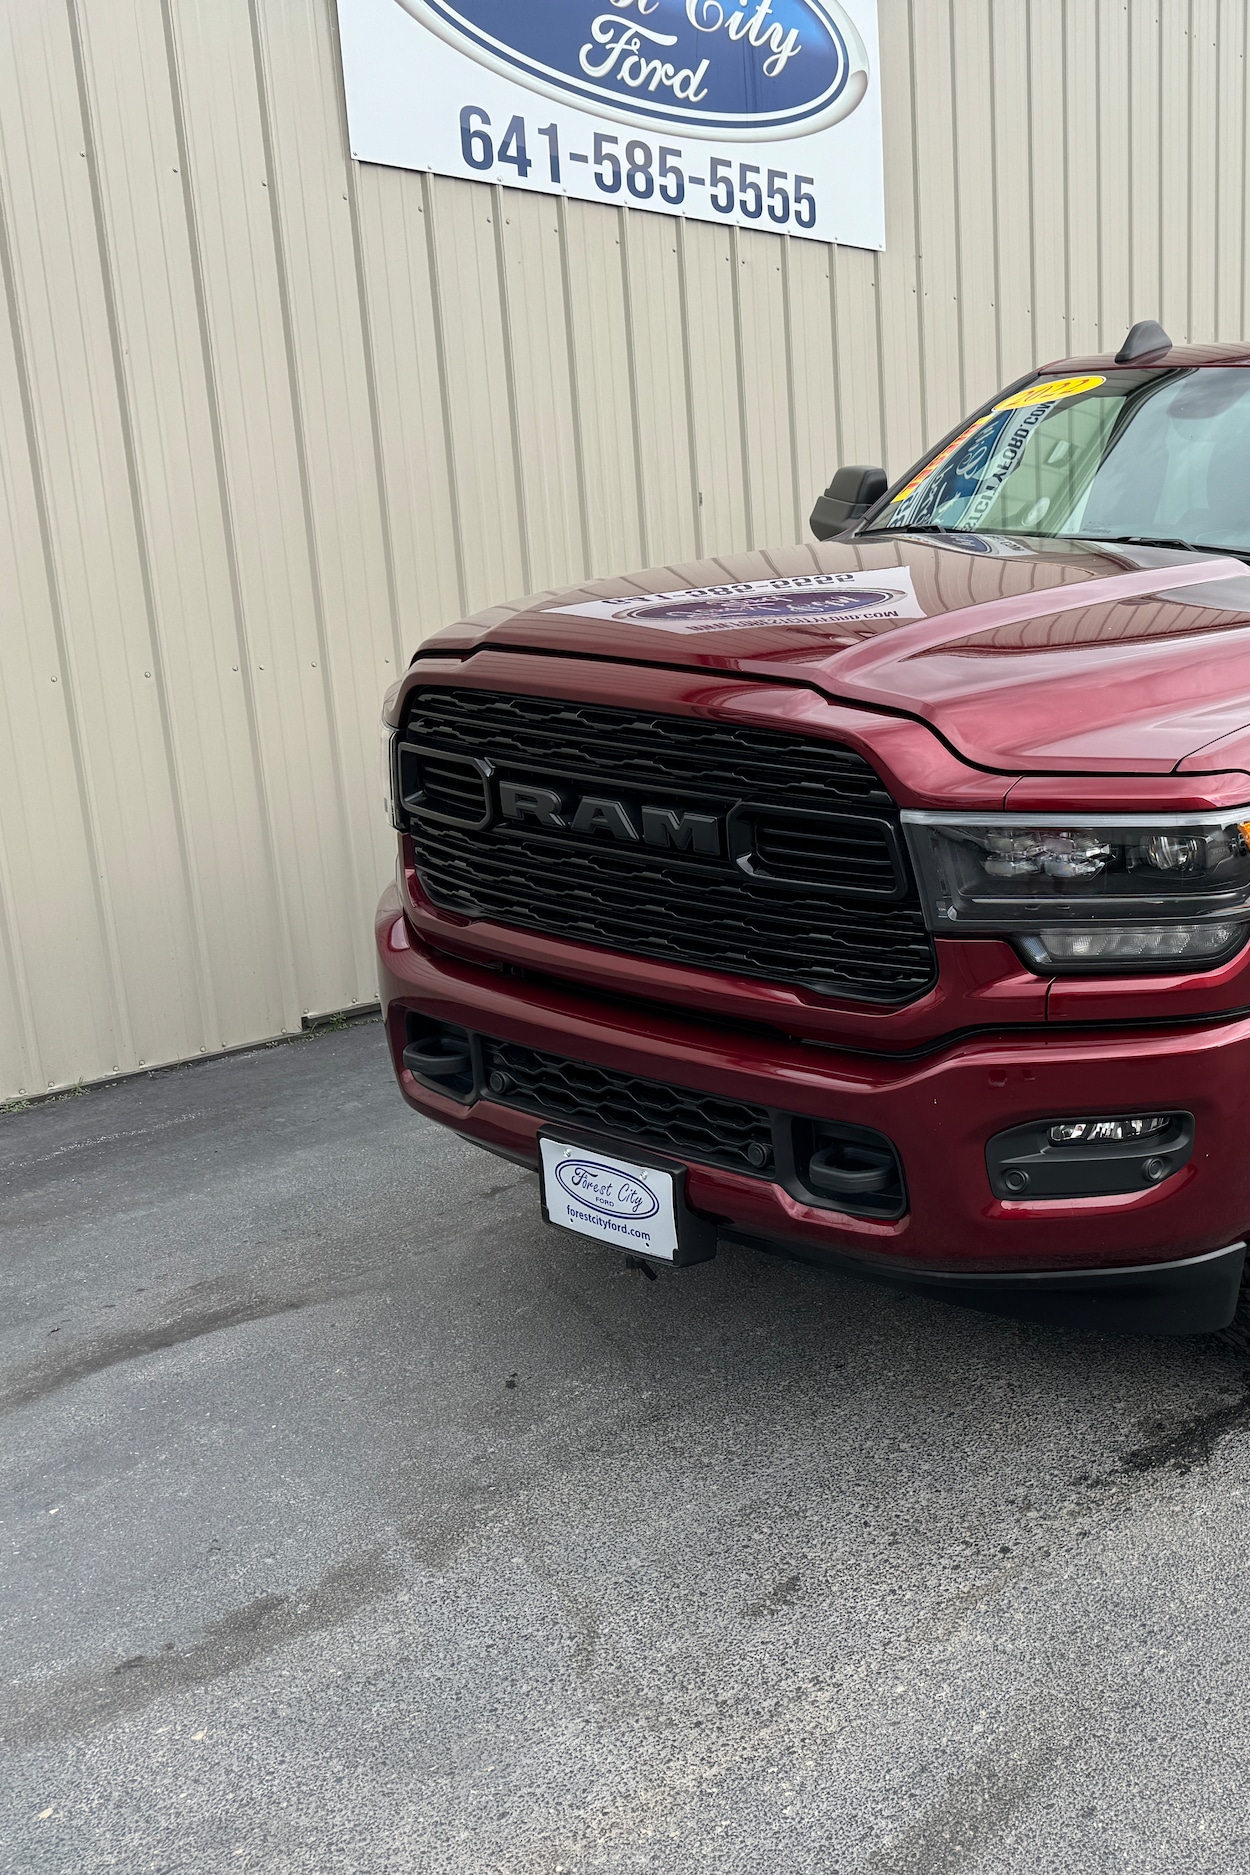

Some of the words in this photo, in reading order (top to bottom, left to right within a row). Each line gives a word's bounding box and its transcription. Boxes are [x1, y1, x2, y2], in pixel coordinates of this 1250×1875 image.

[579, 14, 711, 103] Ford
[458, 104, 818, 229] 641-585-5555
[498, 779, 721, 856] RAM
[571, 1167, 612, 1198] Forest
[617, 1183, 644, 1212] City
[595, 1196, 615, 1207] FORD
[566, 1205, 651, 1241] forestcityford.com
